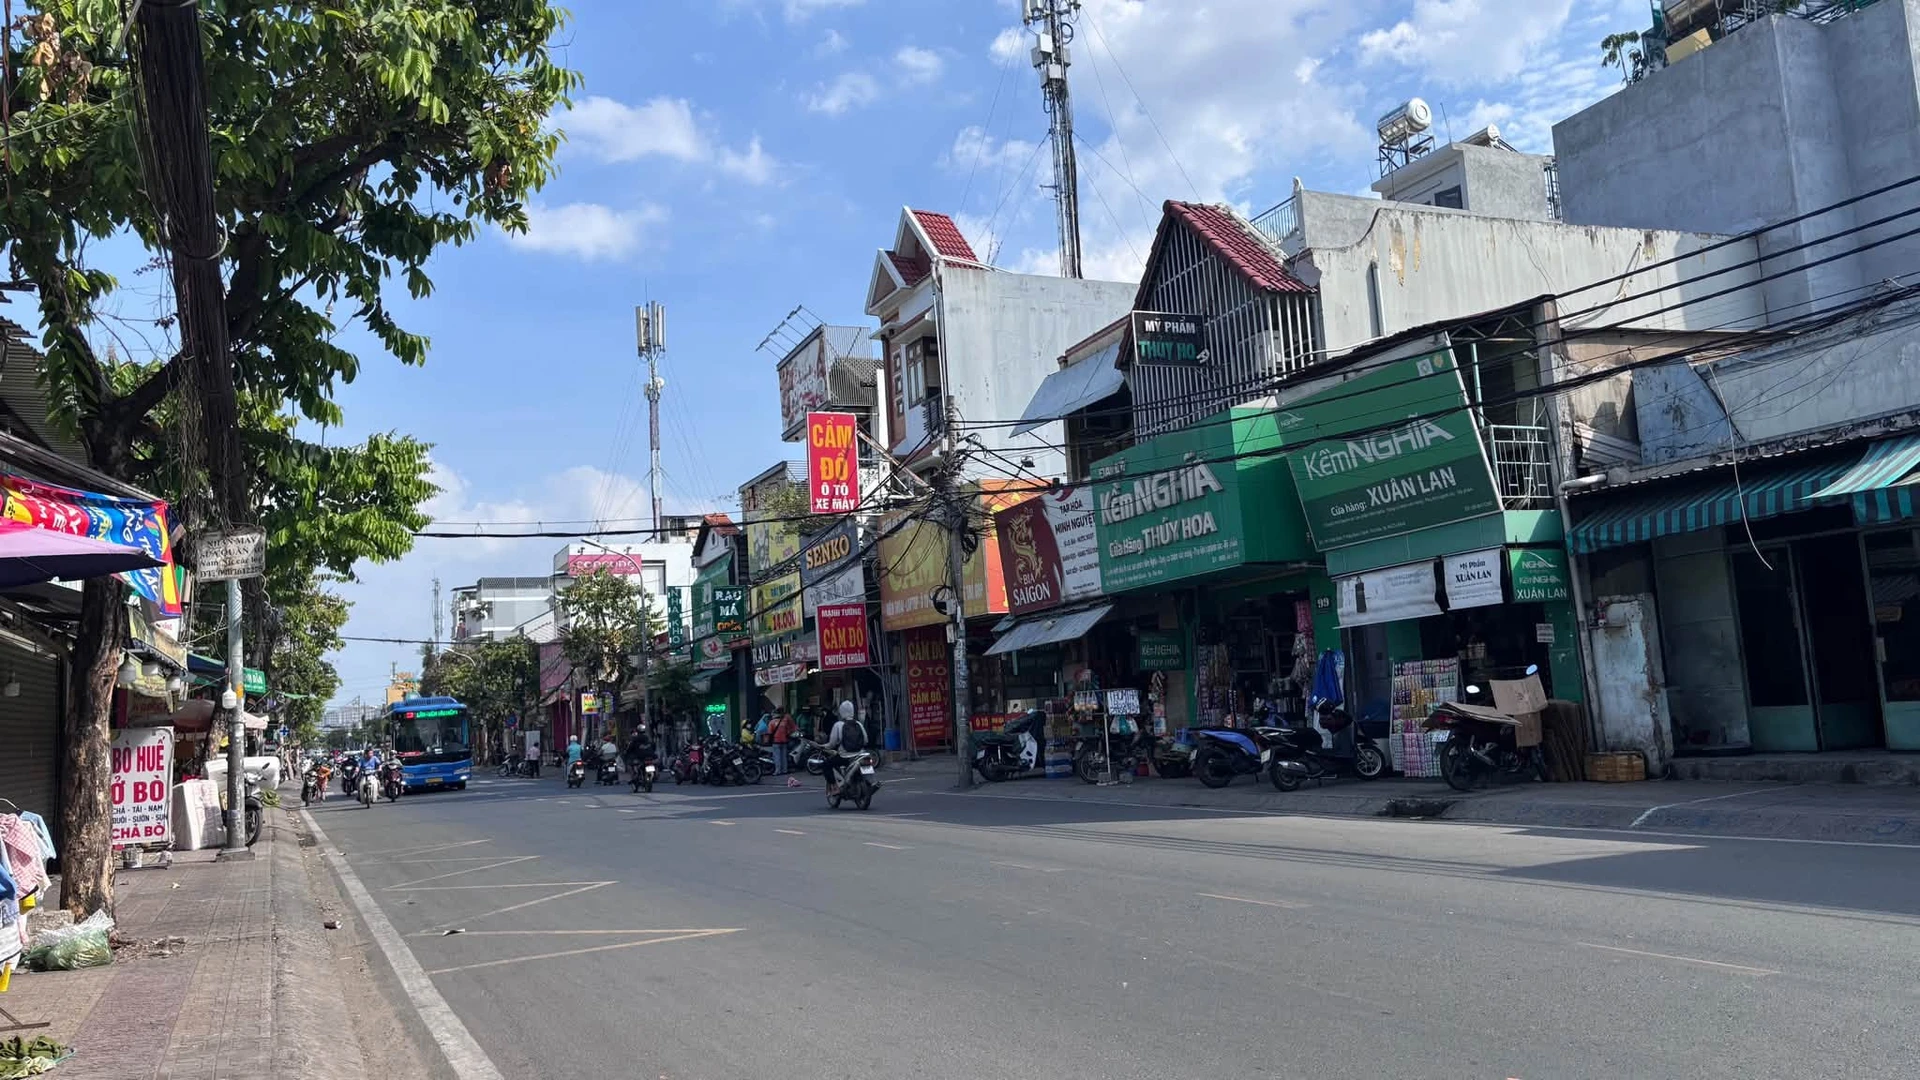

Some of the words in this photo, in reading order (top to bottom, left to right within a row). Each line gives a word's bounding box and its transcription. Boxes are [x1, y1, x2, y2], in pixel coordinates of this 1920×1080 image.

[1144, 317, 1161, 332] MỸ
[1164, 316, 1196, 334] PHẨM
[812, 416, 853, 449] CẦM
[820, 449, 849, 481] ĐỒ
[821, 482, 830, 496] Ô
[833, 482, 849, 496] TÔ
[1366, 477, 1417, 507] XUÂN
[1417, 466, 1457, 494] LAN
[815, 498, 829, 510] XE
[832, 495, 855, 511] MÁY
[1330, 503, 1345, 517] Cửa
[1345, 500, 1368, 516] hàng:
[1055, 521, 1071, 535] MINH
[1071, 510, 1096, 532] NGUYỆT
[1181, 511, 1217, 539] HOA
[806, 534, 850, 570] SENKO
[1023, 573, 1035, 585] BIA
[1455, 569, 1477, 583] XUÂN
[1477, 570, 1492, 580] LAN
[1013, 581, 1051, 606] SAIGON
[1317, 597, 1330, 608] 99
[1516, 586, 1545, 600] XUÂN
[1547, 587, 1567, 599] LAN
[719, 602, 739, 616] MÁ
[769, 637, 782, 660] MÁ
[112, 740, 132, 774] BÒ
[136, 736, 165, 773] HUẾ
[133, 775, 165, 804] BÒ
[144, 821, 166, 837] BÒ
